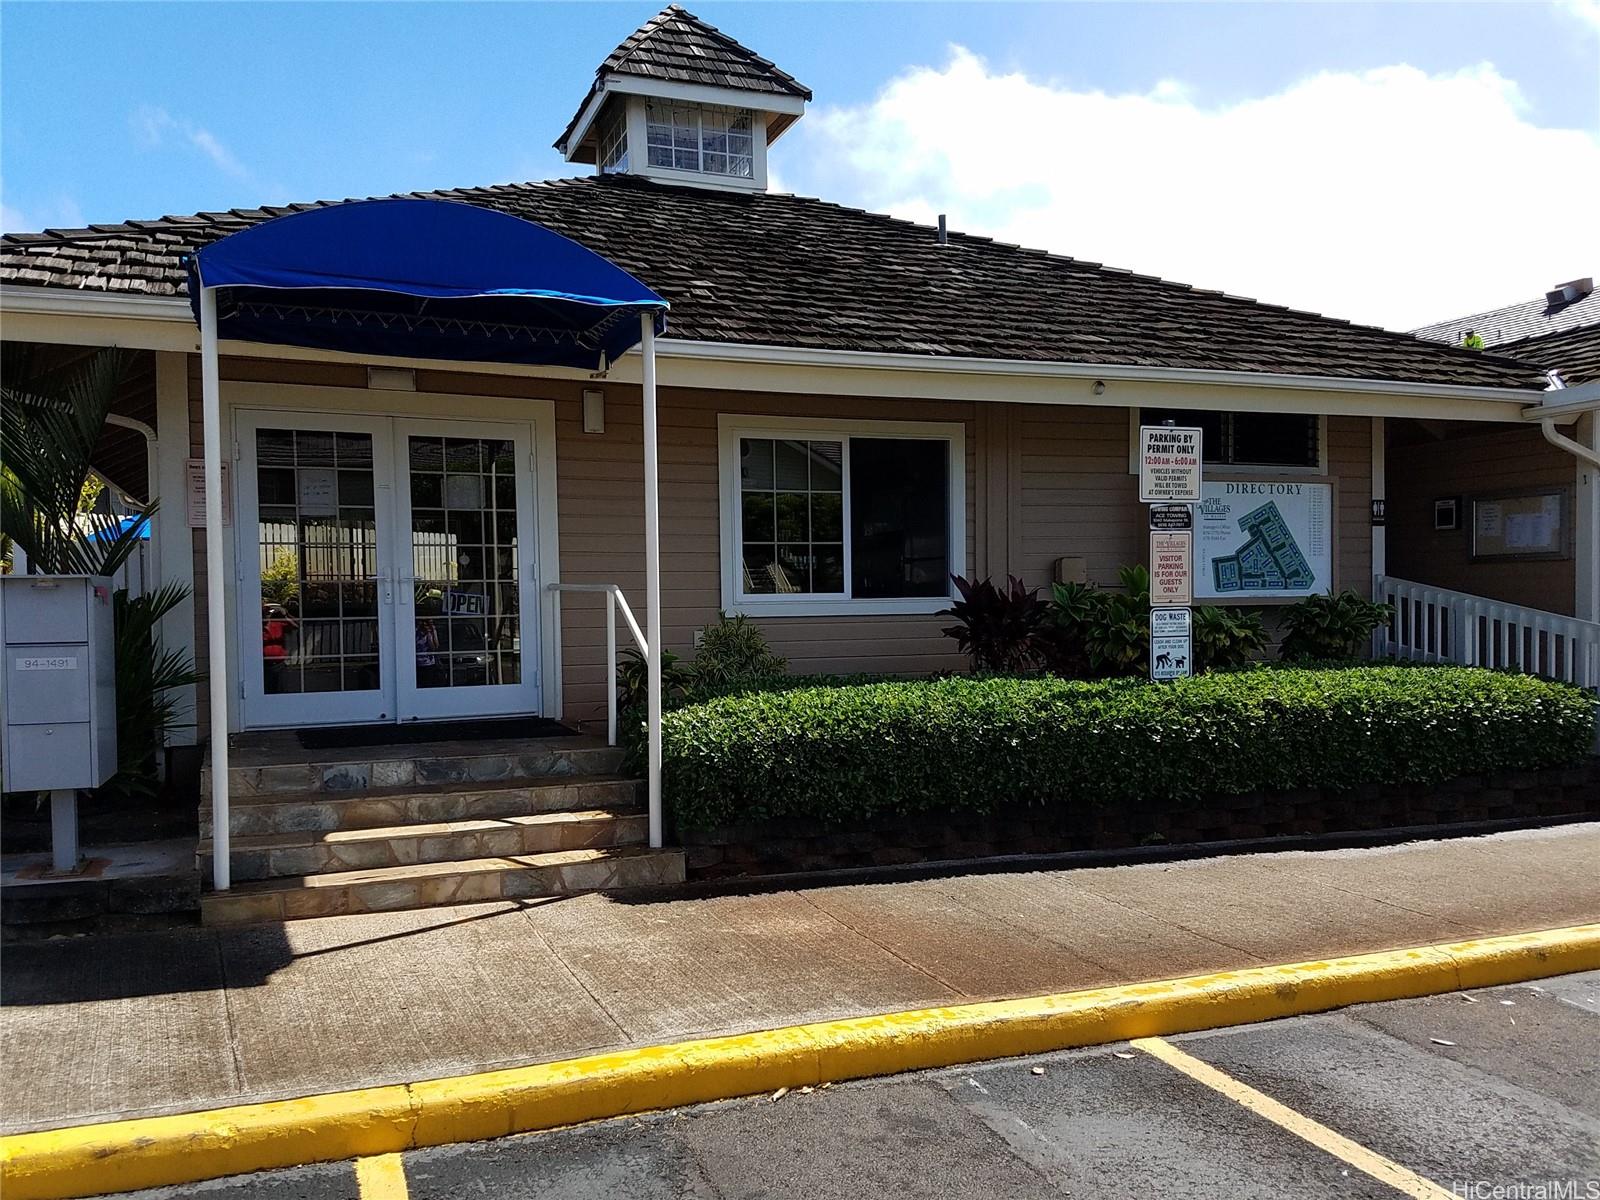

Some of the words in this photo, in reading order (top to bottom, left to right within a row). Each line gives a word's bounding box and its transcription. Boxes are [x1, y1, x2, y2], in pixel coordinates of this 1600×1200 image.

[1149, 433, 1182, 443] PARKING
[1184, 434, 1193, 444] BY
[1147, 444, 1174, 454] PERMIT
[1176, 445, 1195, 454] ONLY
[1226, 483, 1302, 495] DIRECTORY
[1197, 504, 1231, 515] VILLAGES
[446, 594, 486, 613] OPEN
[1169, 612, 1187, 620] WASTE
[24, 660, 68, 668] 94-1491
